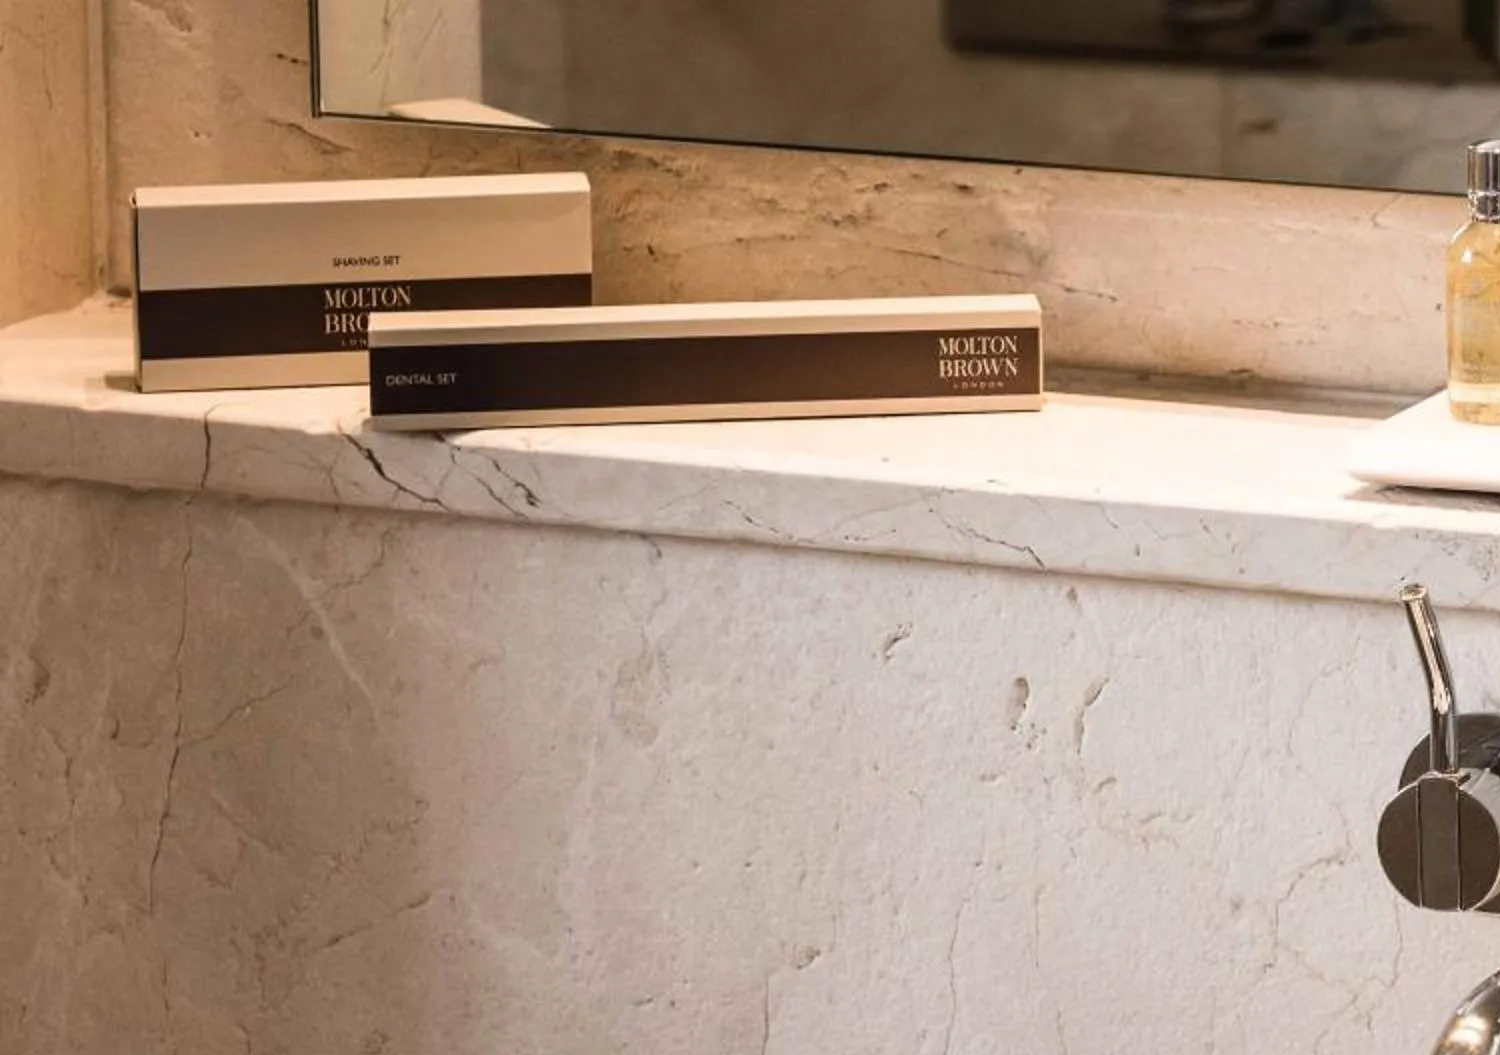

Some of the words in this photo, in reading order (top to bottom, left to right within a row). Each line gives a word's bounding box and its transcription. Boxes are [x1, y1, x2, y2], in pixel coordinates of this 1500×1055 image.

[332, 255, 381, 268] SHAVING
[383, 255, 401, 266] SET
[324, 285, 412, 309] MOLTON
[324, 312, 369, 335] BRO
[939, 335, 1018, 357] MOLTON
[939, 357, 1020, 379] BROWN
[385, 374, 434, 387] DENTAL
[437, 372, 458, 385] SET
[953, 380, 1005, 390] LONDON
